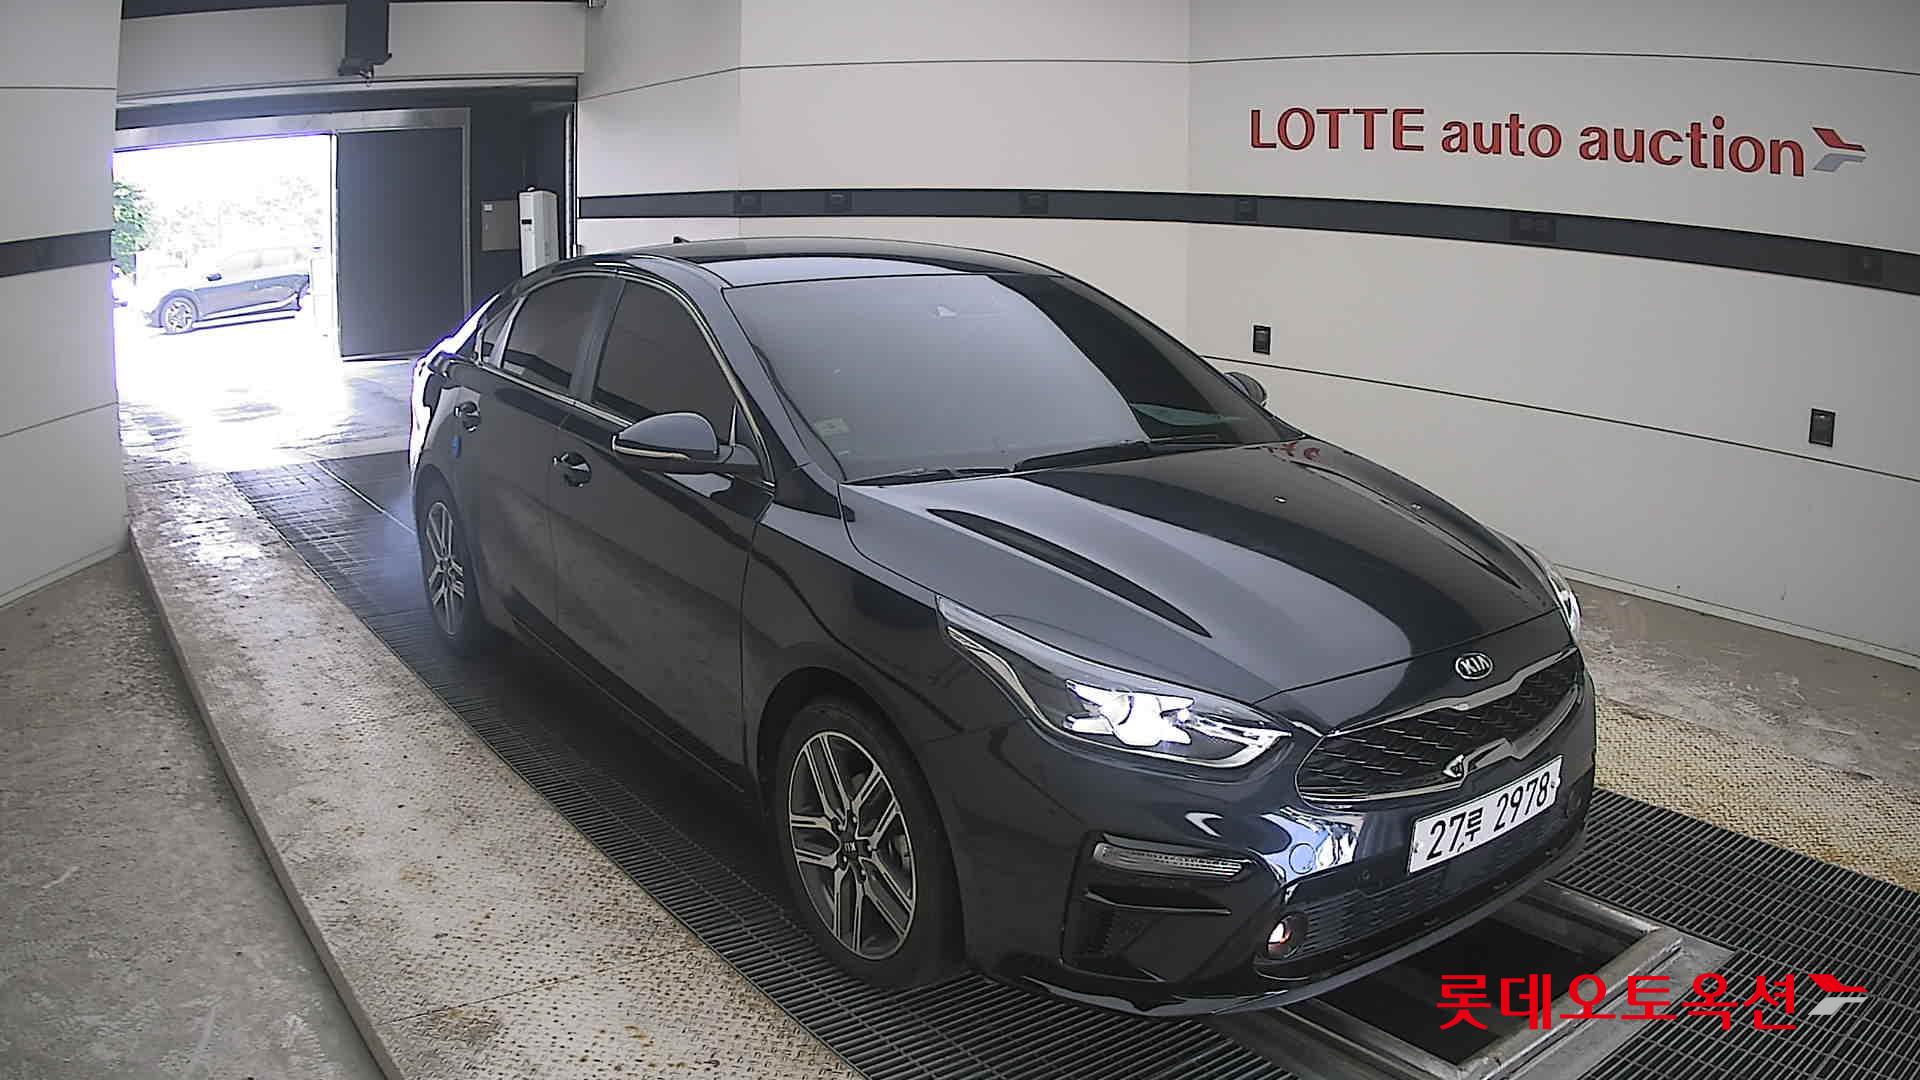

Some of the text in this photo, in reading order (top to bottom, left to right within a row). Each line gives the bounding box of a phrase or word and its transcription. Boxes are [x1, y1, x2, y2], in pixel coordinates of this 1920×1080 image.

[1249, 106, 1806, 178] LOTTE auto auction
[1460, 655, 1490, 675] KIA
[1425, 770, 1551, 861] 27루 2978
